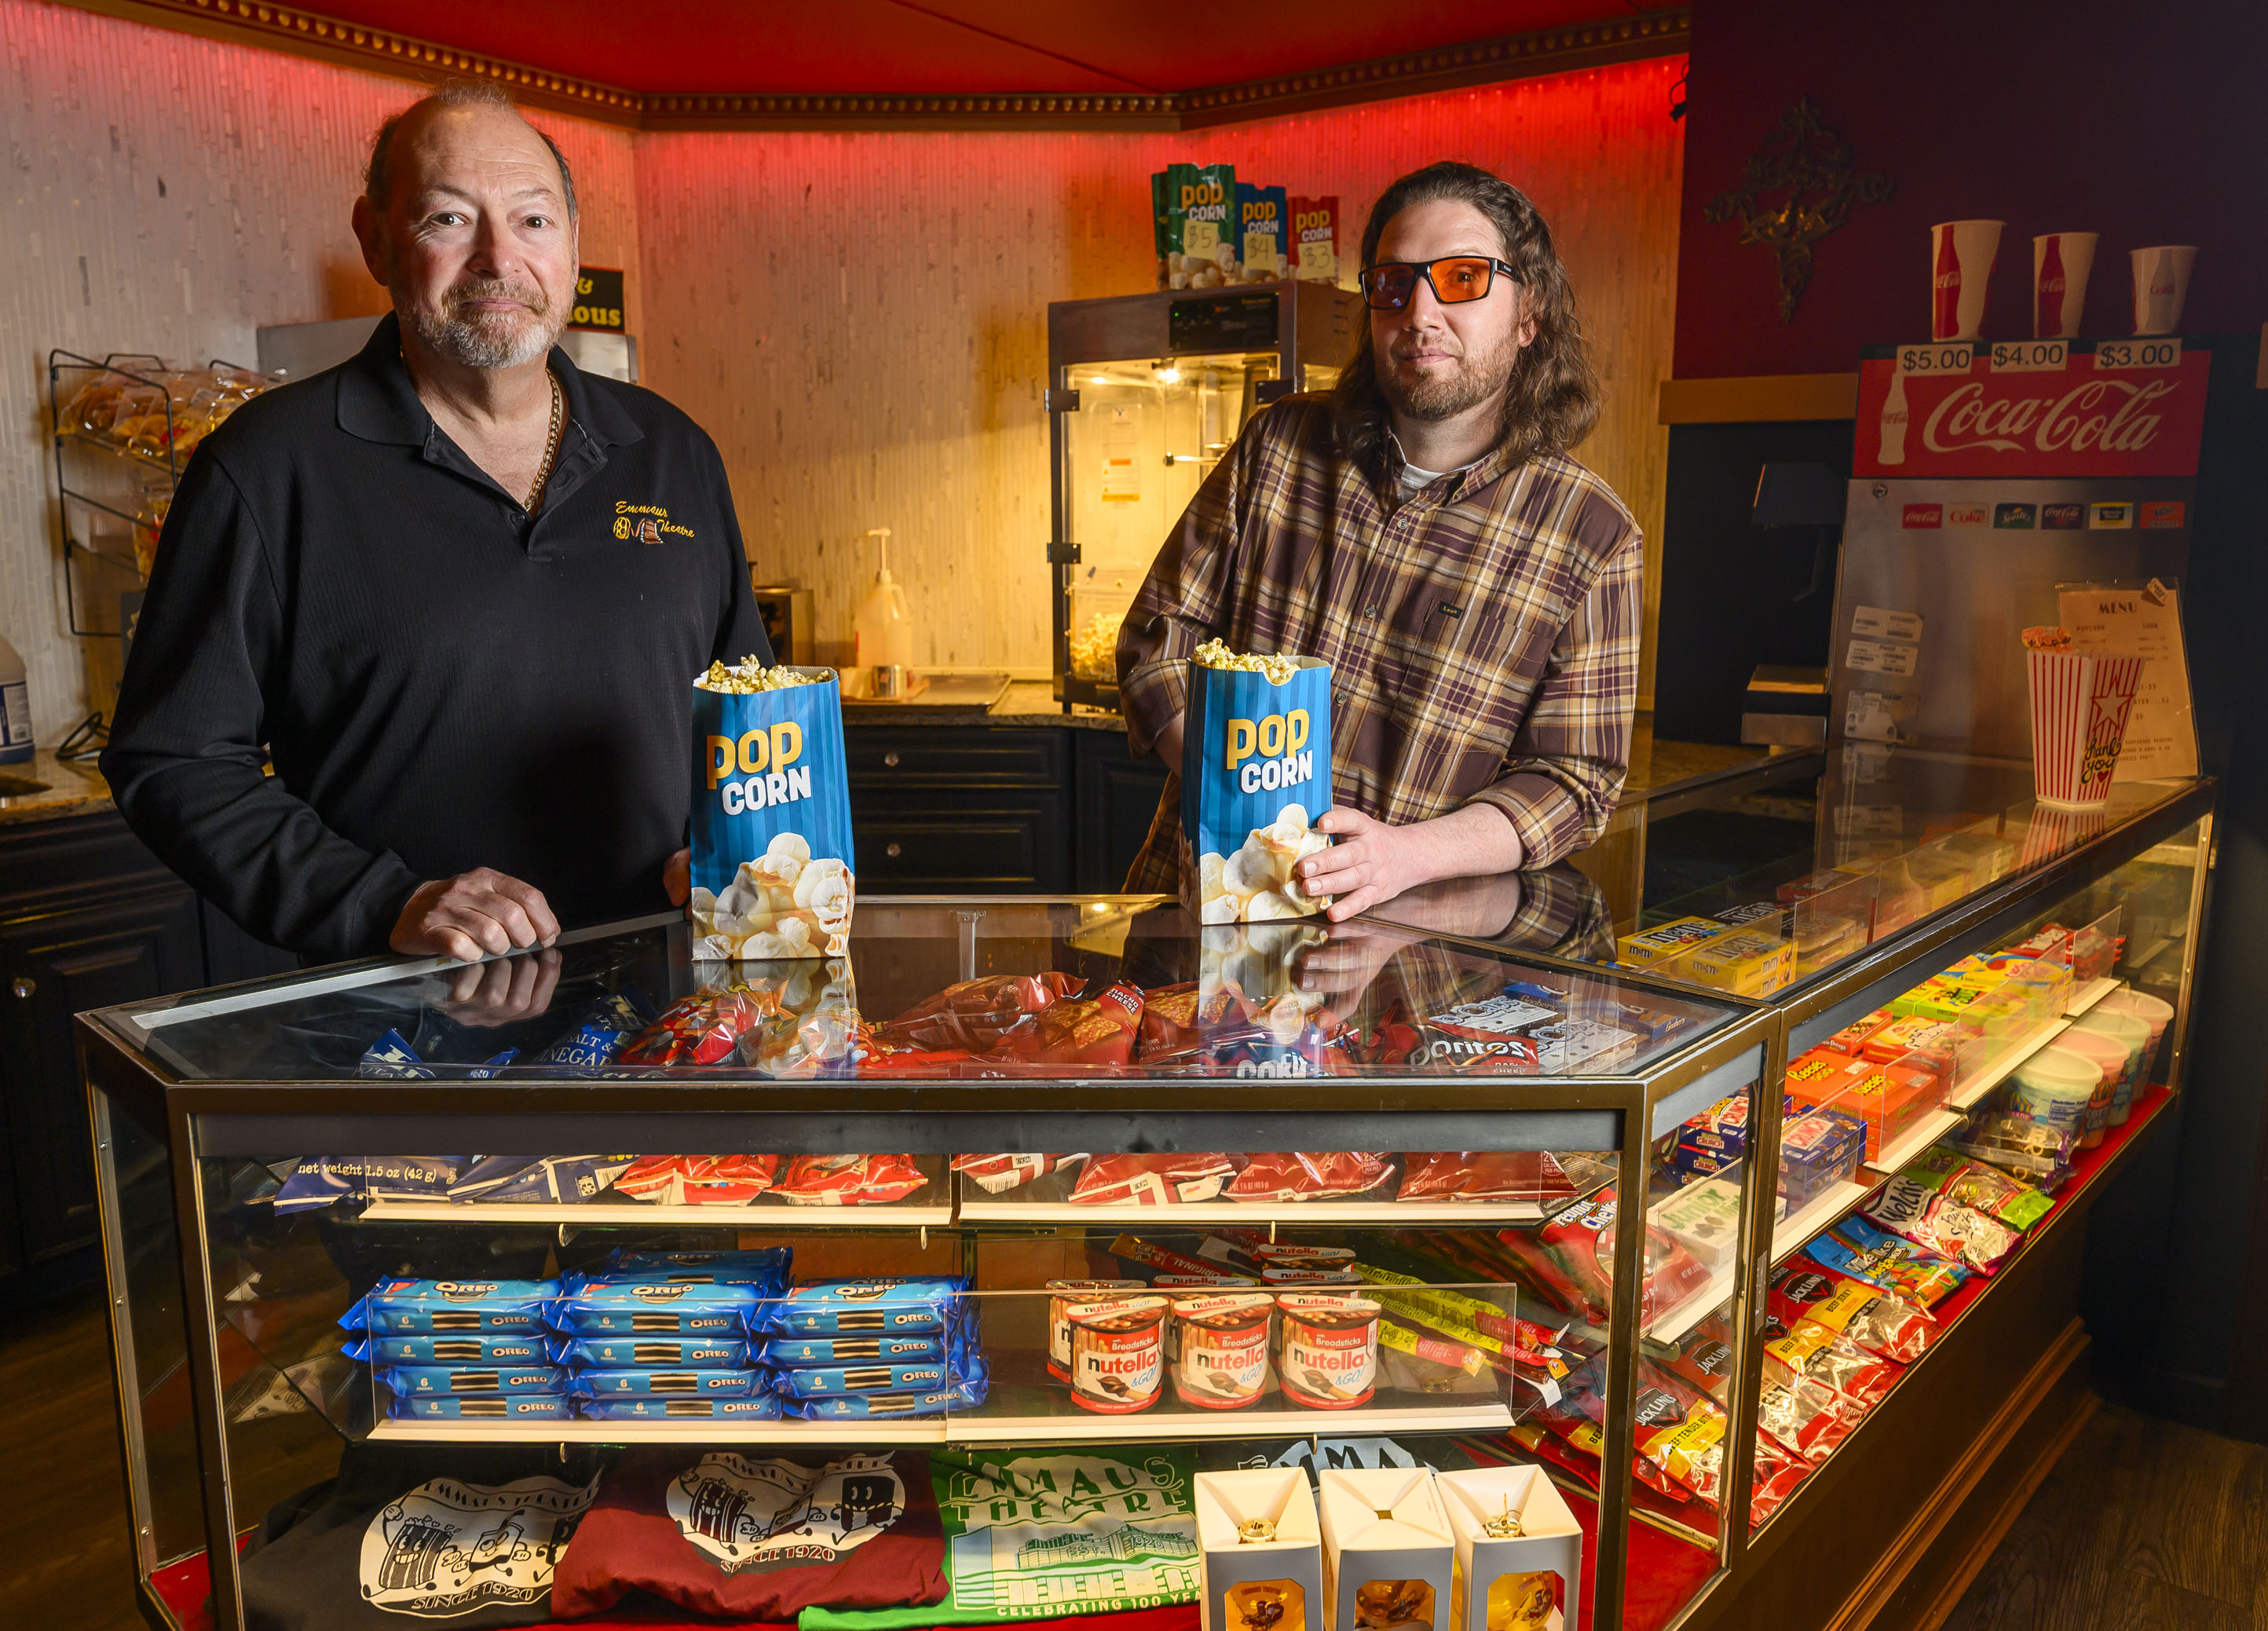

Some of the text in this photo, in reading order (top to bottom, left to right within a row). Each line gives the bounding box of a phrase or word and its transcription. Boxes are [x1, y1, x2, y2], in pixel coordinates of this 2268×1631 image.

[1182, 183, 1223, 209] POP
[1189, 206, 1226, 221] CORN
[1242, 202, 1276, 225] POP
[1297, 210, 1330, 233] POP
[1247, 221, 1278, 234] CORN
[1301, 227, 1332, 242] CORN
[1188, 226, 1211, 249] $5
[1249, 240, 1269, 261] $4
[1304, 244, 1331, 269] $3
[577, 278, 593, 294] &
[1903, 349, 1970, 371] $5.00
[1993, 344, 2063, 368] $4.00
[2100, 344, 2173, 367] $3.00
[1922, 380, 2180, 452] Coca-Cola
[657, 518, 695, 538] Theatre
[2098, 602, 2136, 614] MENU
[1227, 708, 1310, 770] POP
[707, 722, 803, 790] POP
[1241, 750, 1313, 794] CORN
[722, 766, 812, 815] CORN
[1107, 991, 1136, 1015] CHEESE
[1110, 987, 1139, 1008] NACHO
[1697, 1137, 1724, 1148] CRUNCH
[298, 1163, 437, 1183] net weight 1.5 oz (42 g)
[1694, 1161, 1720, 1172] CRUNCH
[1877, 1179, 1926, 1223] Welch's
[1276, 1246, 1319, 1256] nutella
[1281, 1271, 1324, 1281] nutella
[1863, 1256, 1895, 1280] Mega
[433, 1282, 499, 1293] OREO
[1172, 1277, 1217, 1285] nutella
[631, 1285, 694, 1295] OREO
[835, 1284, 896, 1296] OREO
[1085, 1301, 1129, 1313] nutella
[1192, 1298, 1236, 1309] nutella
[1297, 1296, 1344, 1307] nutella
[1825, 1298, 1839, 1313] BEEF
[491, 1315, 529, 1326] OREO
[690, 1318, 727, 1328] OREO
[894, 1315, 931, 1324] OREO
[890, 1343, 927, 1353] OREO
[1111, 1336, 1154, 1351] Breadsticks
[1222, 1333, 1263, 1348] Breadsticks
[1315, 1337, 1361, 1348] Breadsticks
[492, 1348, 529, 1356] OREO
[691, 1350, 729, 1359] OREO
[1197, 1346, 1264, 1370] nutella
[1293, 1348, 1365, 1371] nutella
[1088, 1351, 1157, 1374] nutella
[902, 1371, 938, 1381] OREO
[1132, 1362, 1158, 1388] &GO!
[1240, 1359, 1264, 1384] &GO!
[1335, 1364, 1366, 1386] &GO!
[509, 1376, 547, 1385] OREO
[620, 1379, 627, 1388] 6
[708, 1379, 745, 1388] OREO
[924, 1392, 961, 1403] OREO
[517, 1403, 554, 1413] OREO
[722, 1402, 760, 1412] OREO
[1681, 1420, 1700, 1442] TENDER
[949, 1456, 1176, 1501] EMMAUS
[951, 1489, 1187, 1522] THEATRE
[785, 1545, 836, 1563] 1920
[1066, 1536, 1163, 1558] EST. 1920
[411, 1581, 535, 1610] SINCE 1920
[997, 1596, 1123, 1617] CELEBRATING
[1132, 1594, 1161, 1609] 100
